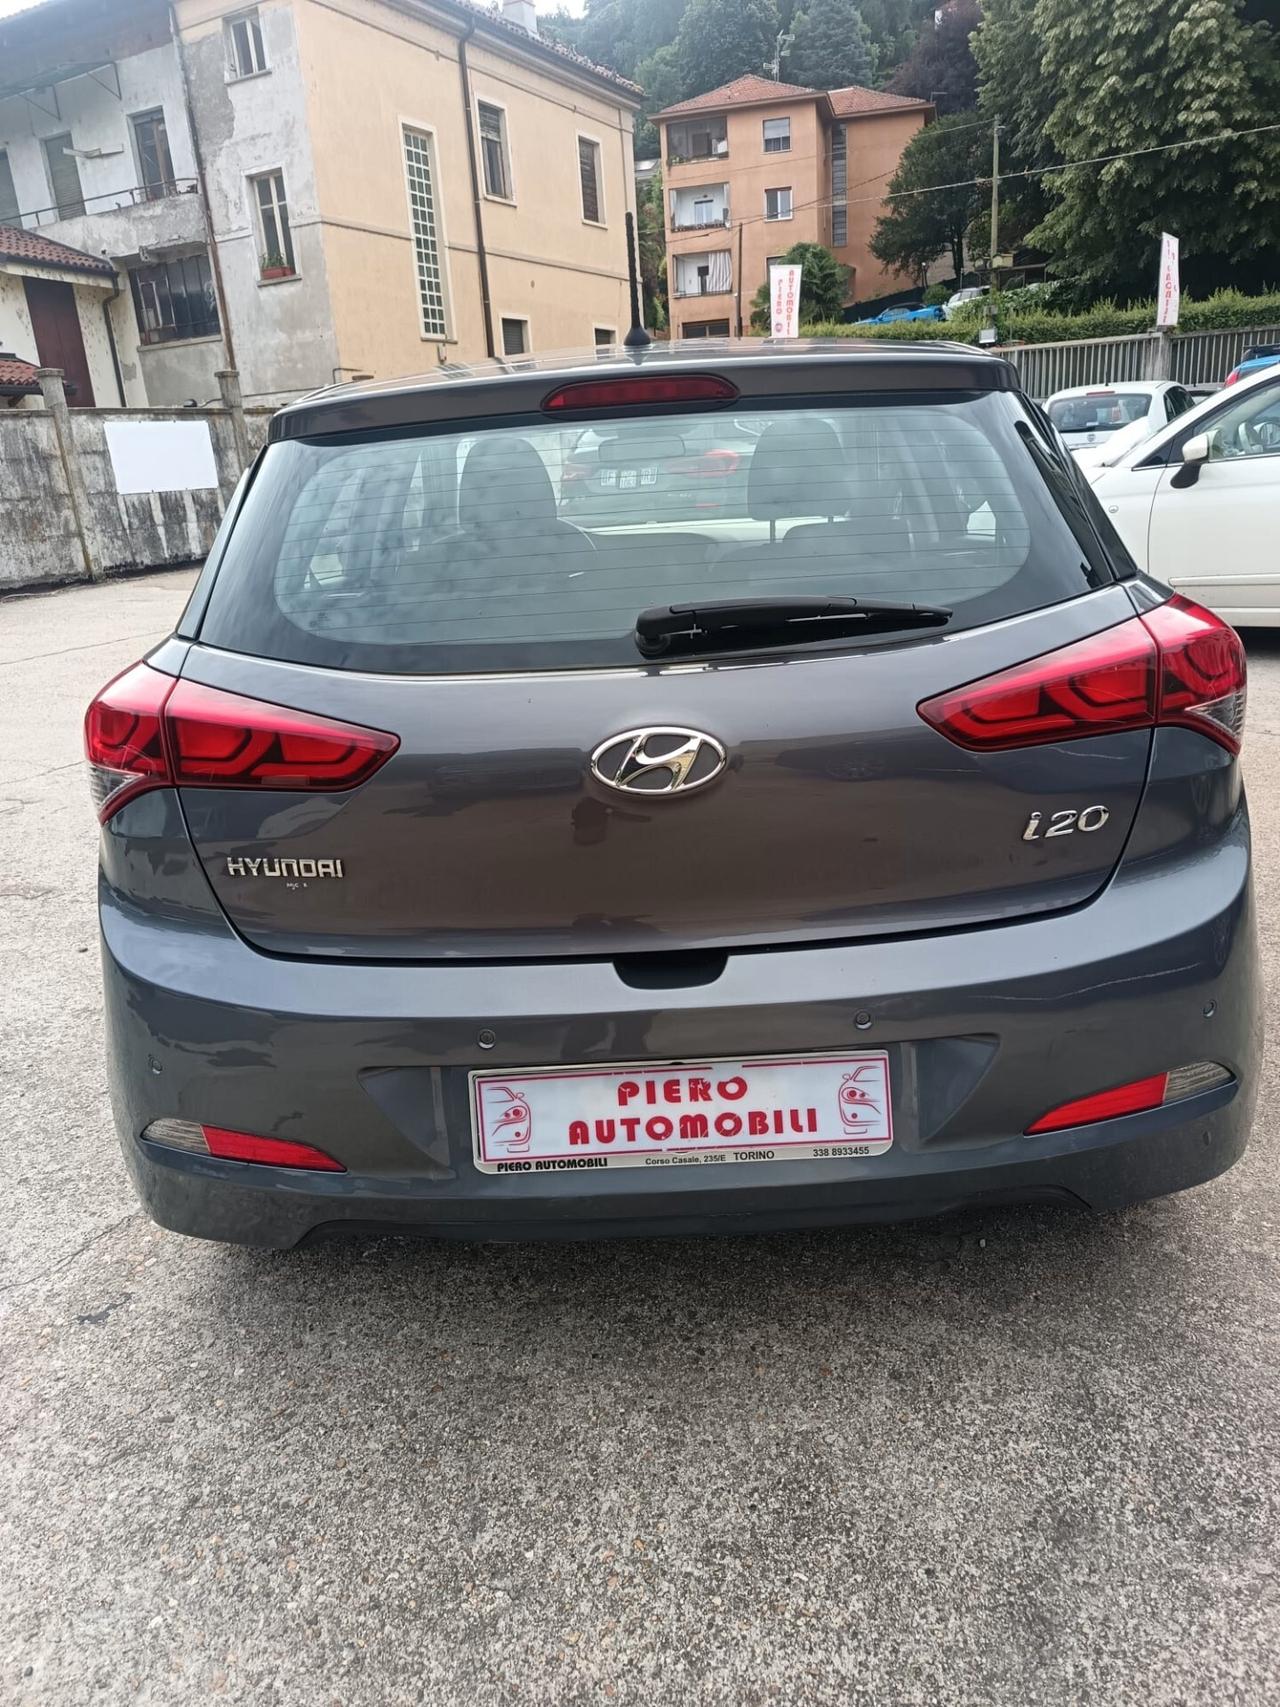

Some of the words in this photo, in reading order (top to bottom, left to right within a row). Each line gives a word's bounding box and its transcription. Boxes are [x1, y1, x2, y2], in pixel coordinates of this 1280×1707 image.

[1023, 805, 1110, 840] i20
[226, 857, 344, 878] HYUNDAI
[617, 1076, 748, 1107] PIERO
[568, 1108, 817, 1146] AUTOMOBILI
[645, 1157, 670, 1165] Corso
[672, 1156, 702, 1165] Casale,
[703, 1154, 727, 1163] 235/E
[733, 1150, 775, 1161] TORINO
[813, 1148, 829, 1157] 338
[832, 1146, 870, 1156] 8933455
[497, 1162, 532, 1172] PIERO
[535, 1158, 608, 1171] AUTOMOBILI
